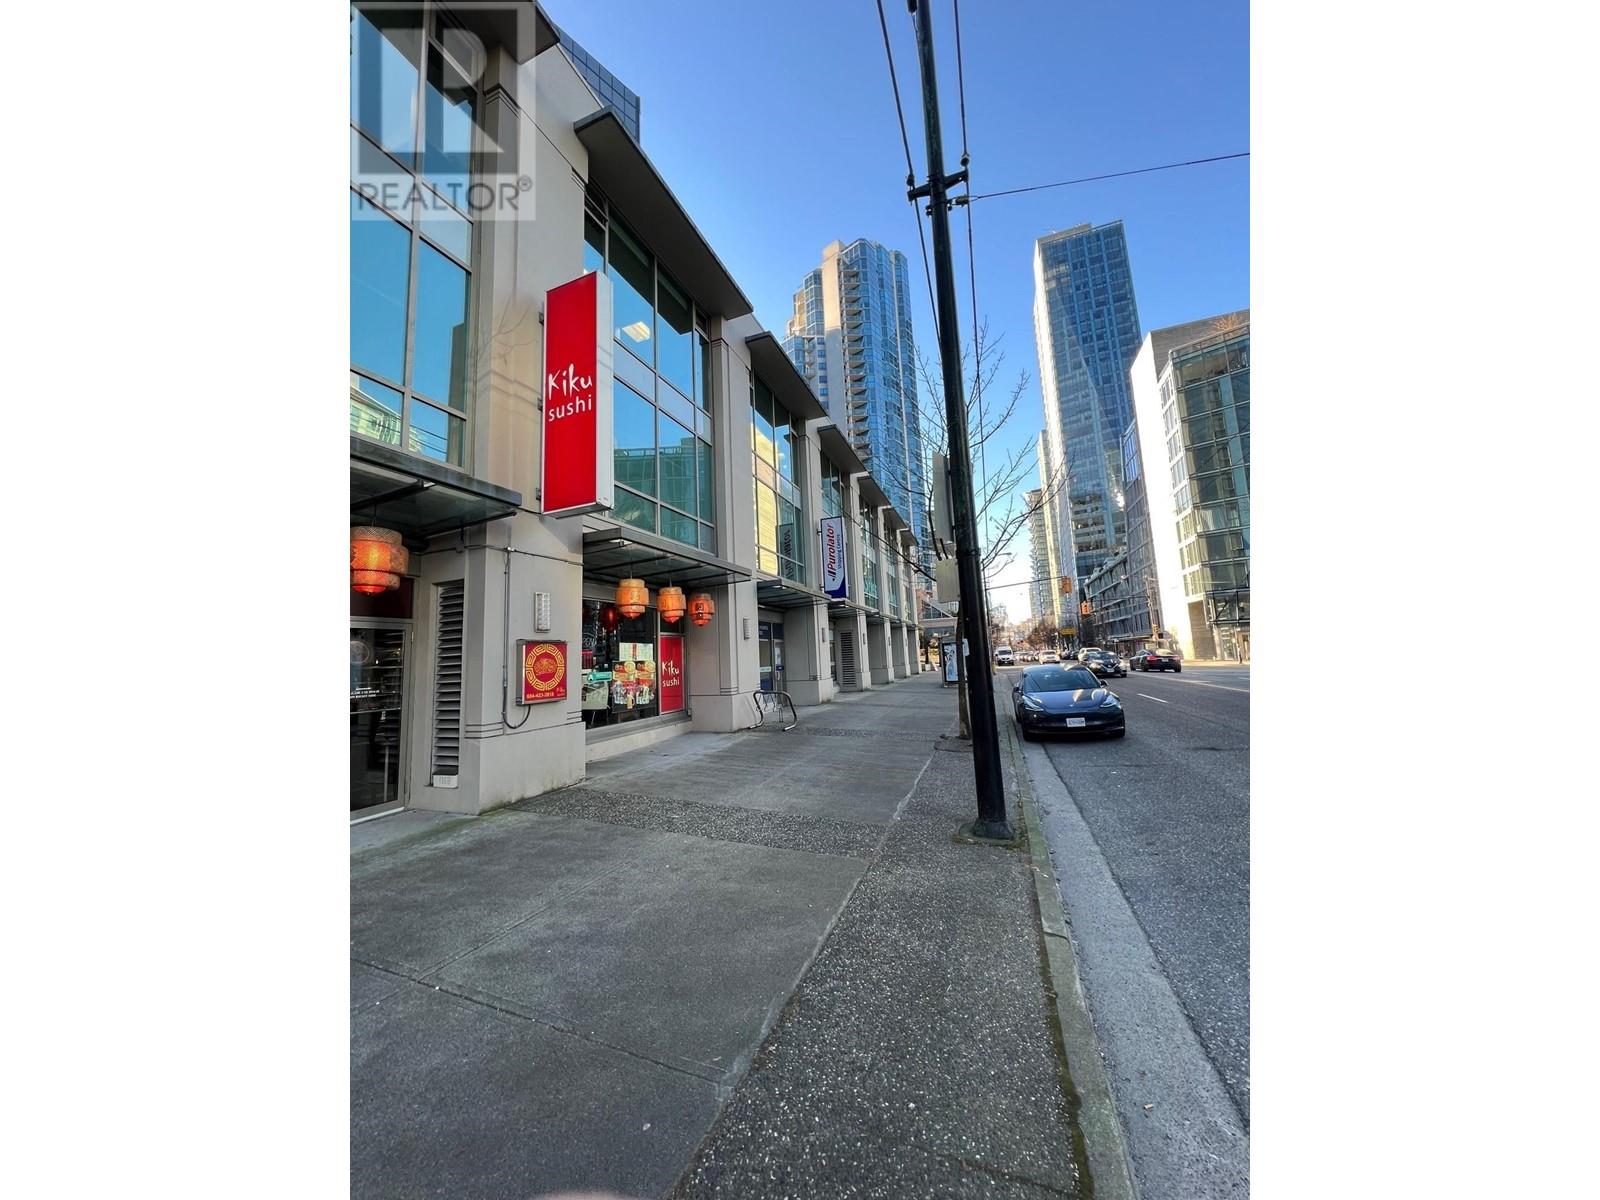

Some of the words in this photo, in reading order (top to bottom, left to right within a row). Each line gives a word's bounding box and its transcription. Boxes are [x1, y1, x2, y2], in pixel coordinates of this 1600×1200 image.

[548, 363, 593, 400] Kiku
[548, 394, 592, 422] sushi
[826, 522, 836, 572] Purolator
[661, 660, 680, 676] Kiku
[662, 676, 680, 688] sushi
